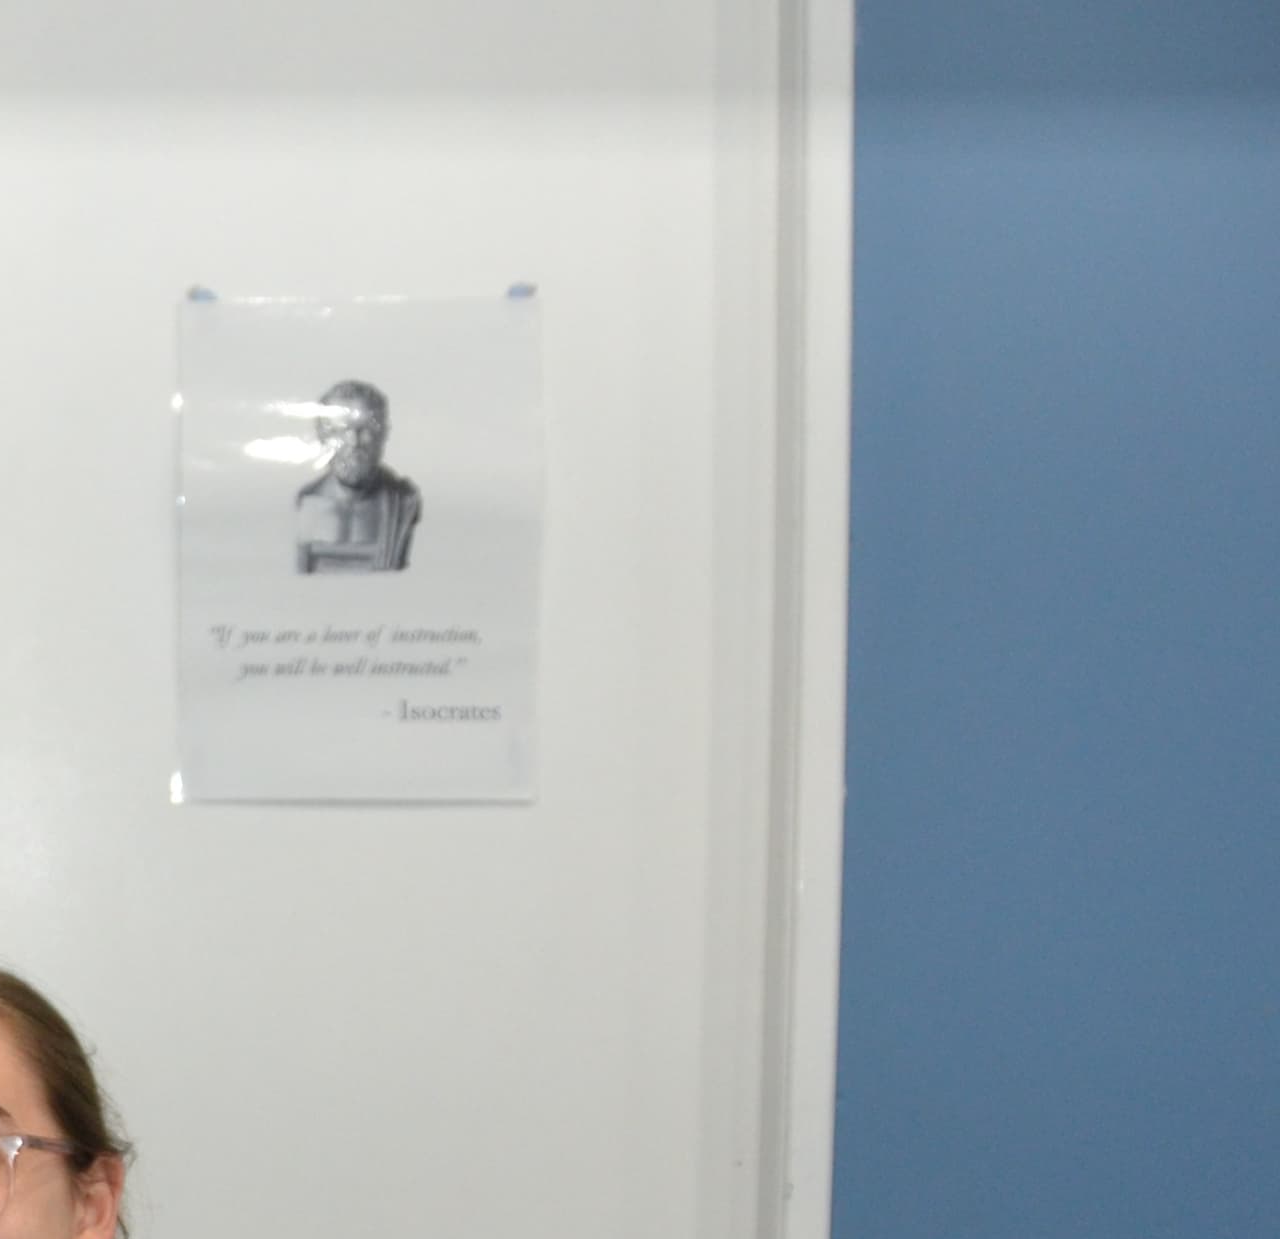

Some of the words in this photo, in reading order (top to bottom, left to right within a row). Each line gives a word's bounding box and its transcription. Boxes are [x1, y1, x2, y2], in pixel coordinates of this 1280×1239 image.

[237, 629, 270, 648] you
[276, 629, 301, 644] are
[307, 631, 318, 644] a
[323, 626, 361, 644] lover
[366, 625, 384, 647] of
[392, 626, 483, 646] instruction,
[236, 660, 269, 681] you
[275, 657, 306, 676] will
[311, 658, 328, 675] be
[334, 657, 368, 676] well
[399, 700, 501, 721] Isocrates
